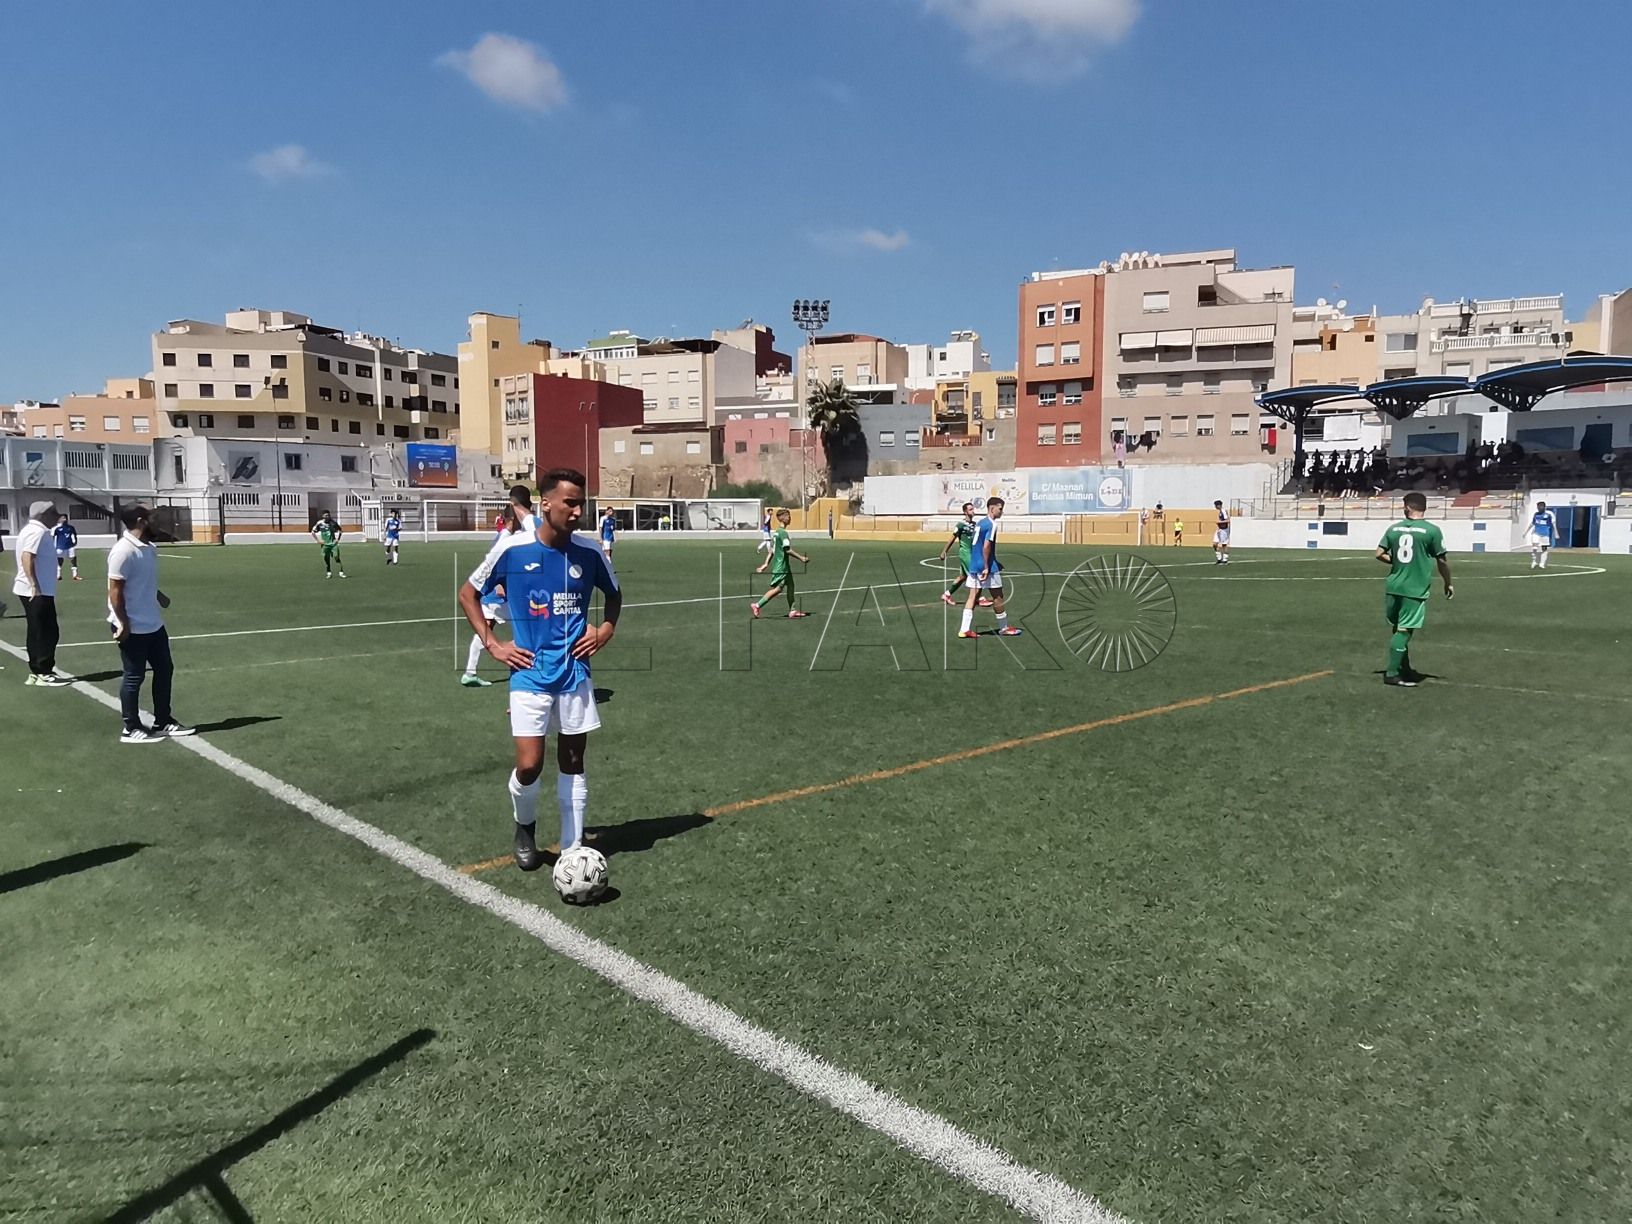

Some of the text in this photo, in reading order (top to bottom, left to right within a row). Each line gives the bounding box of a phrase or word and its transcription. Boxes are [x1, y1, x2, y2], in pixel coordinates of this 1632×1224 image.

[954, 483, 985, 491] MELILLA
[1066, 492, 1094, 500] Mimun
[1397, 533, 1414, 564] 8
[553, 592, 582, 600] MELILLA
[553, 607, 581, 615] CAPITAL
